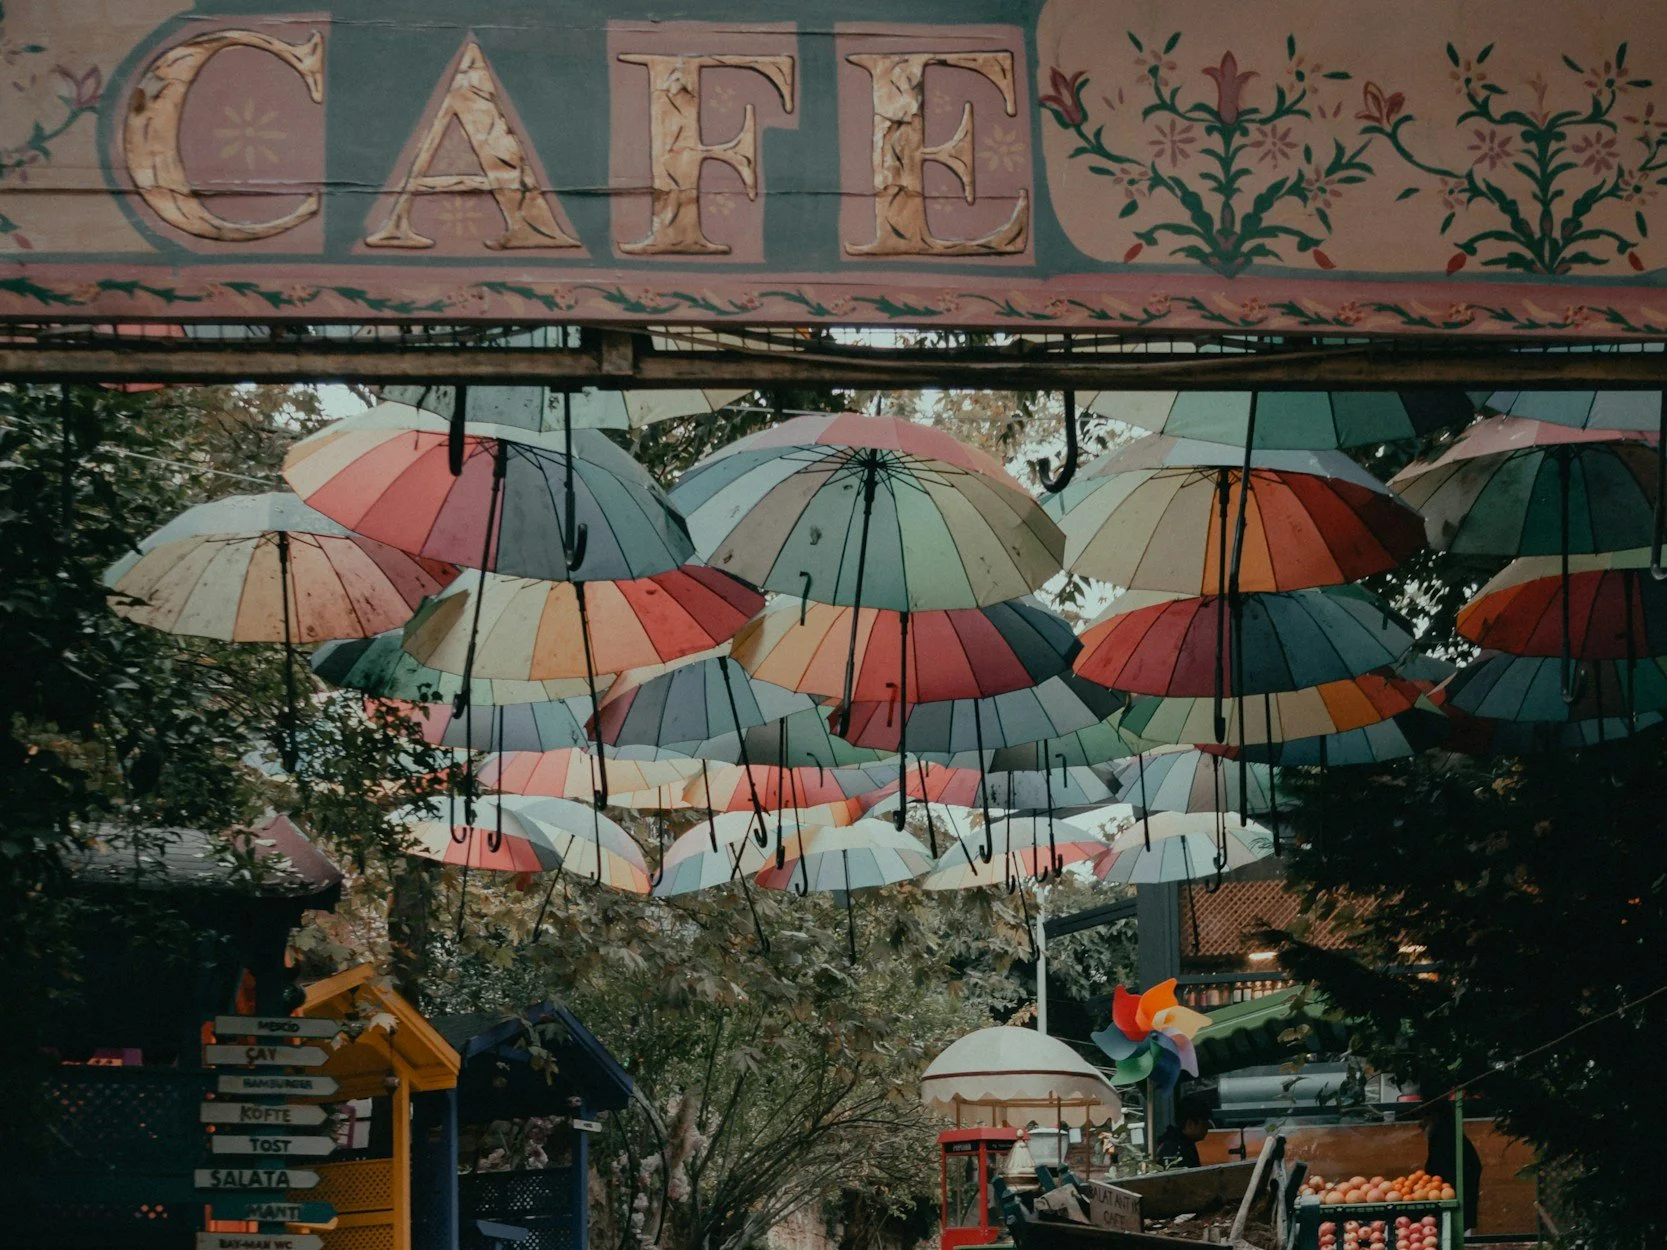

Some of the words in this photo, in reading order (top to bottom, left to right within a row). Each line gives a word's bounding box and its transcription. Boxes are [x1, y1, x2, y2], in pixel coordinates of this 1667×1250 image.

[124, 30, 1029, 258] CAFE
[246, 1047, 277, 1063] ÇAY
[249, 1138, 292, 1152] TOST
[210, 1169, 290, 1188] SALATA
[274, 1240, 293, 1250] WC
